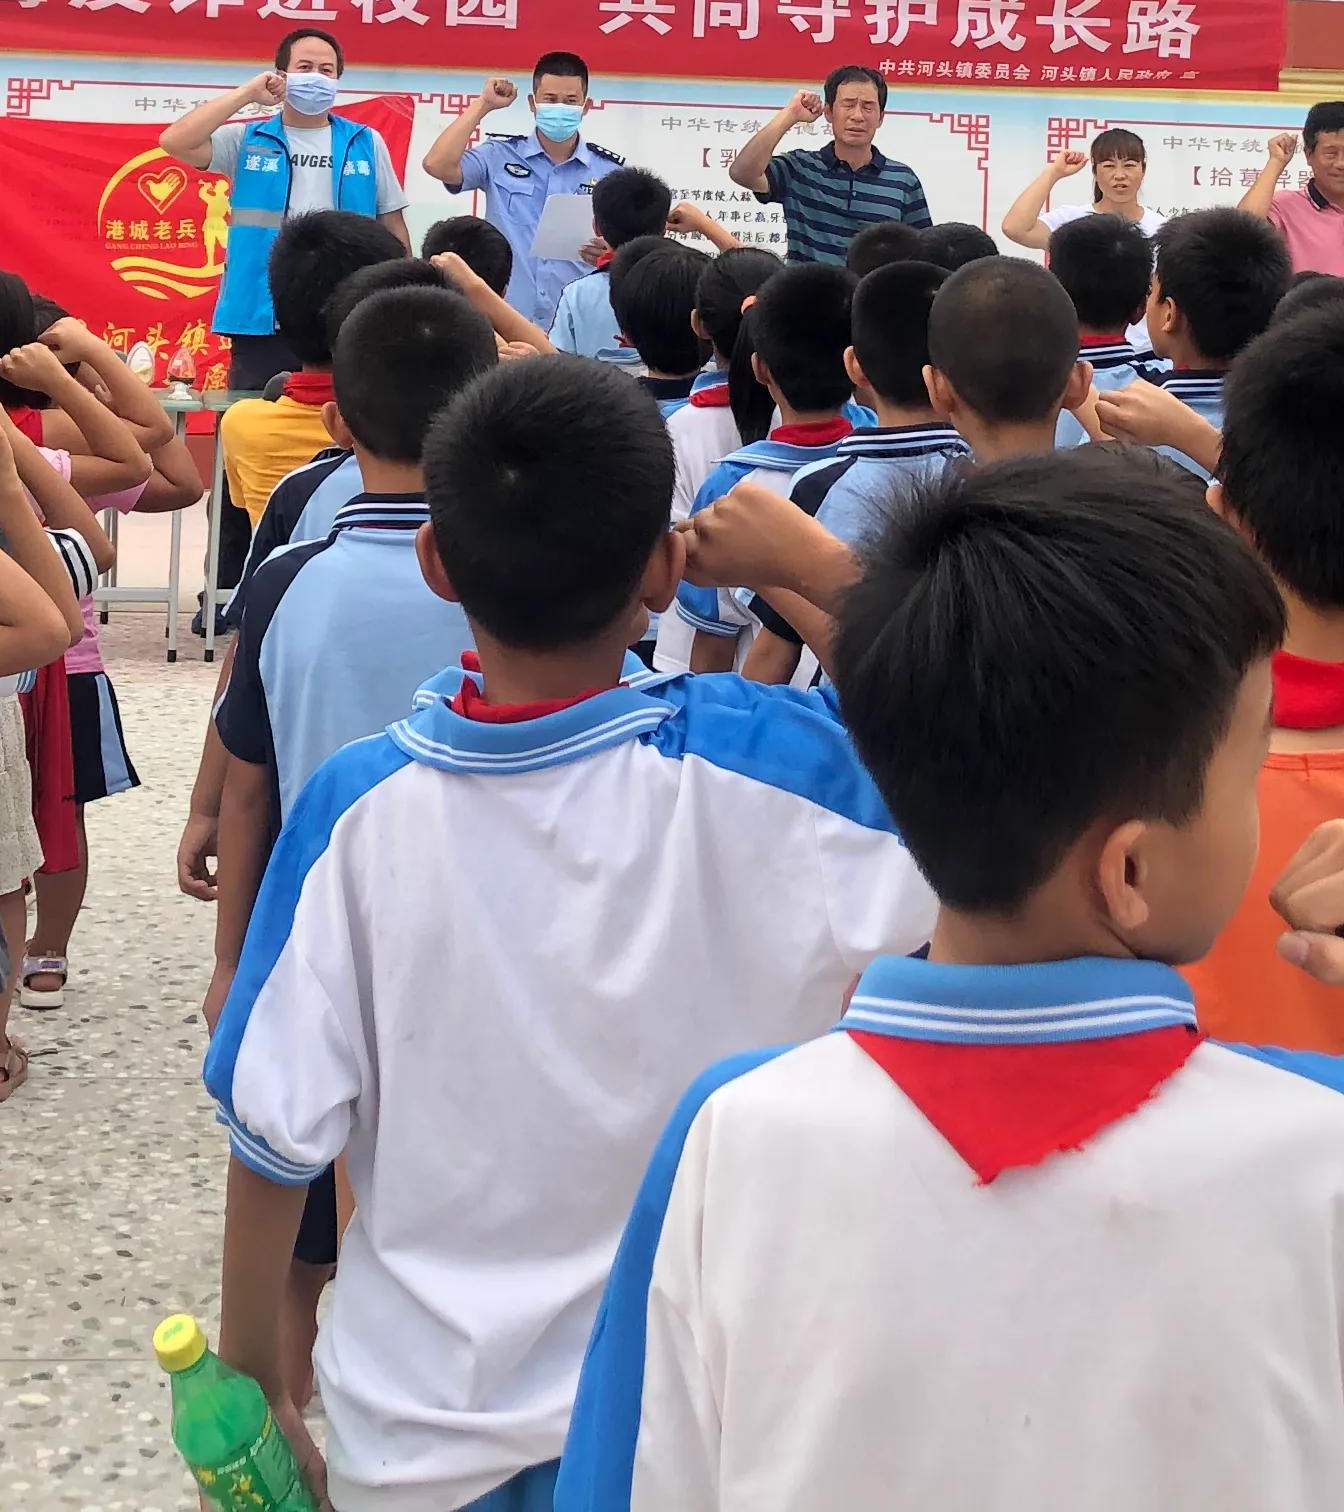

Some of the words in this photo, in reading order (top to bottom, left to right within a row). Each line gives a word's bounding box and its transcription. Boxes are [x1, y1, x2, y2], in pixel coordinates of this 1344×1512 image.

[878, 58, 1032, 82] 中共河头镇委员会
[105, 219, 197, 241] 港城老兵
